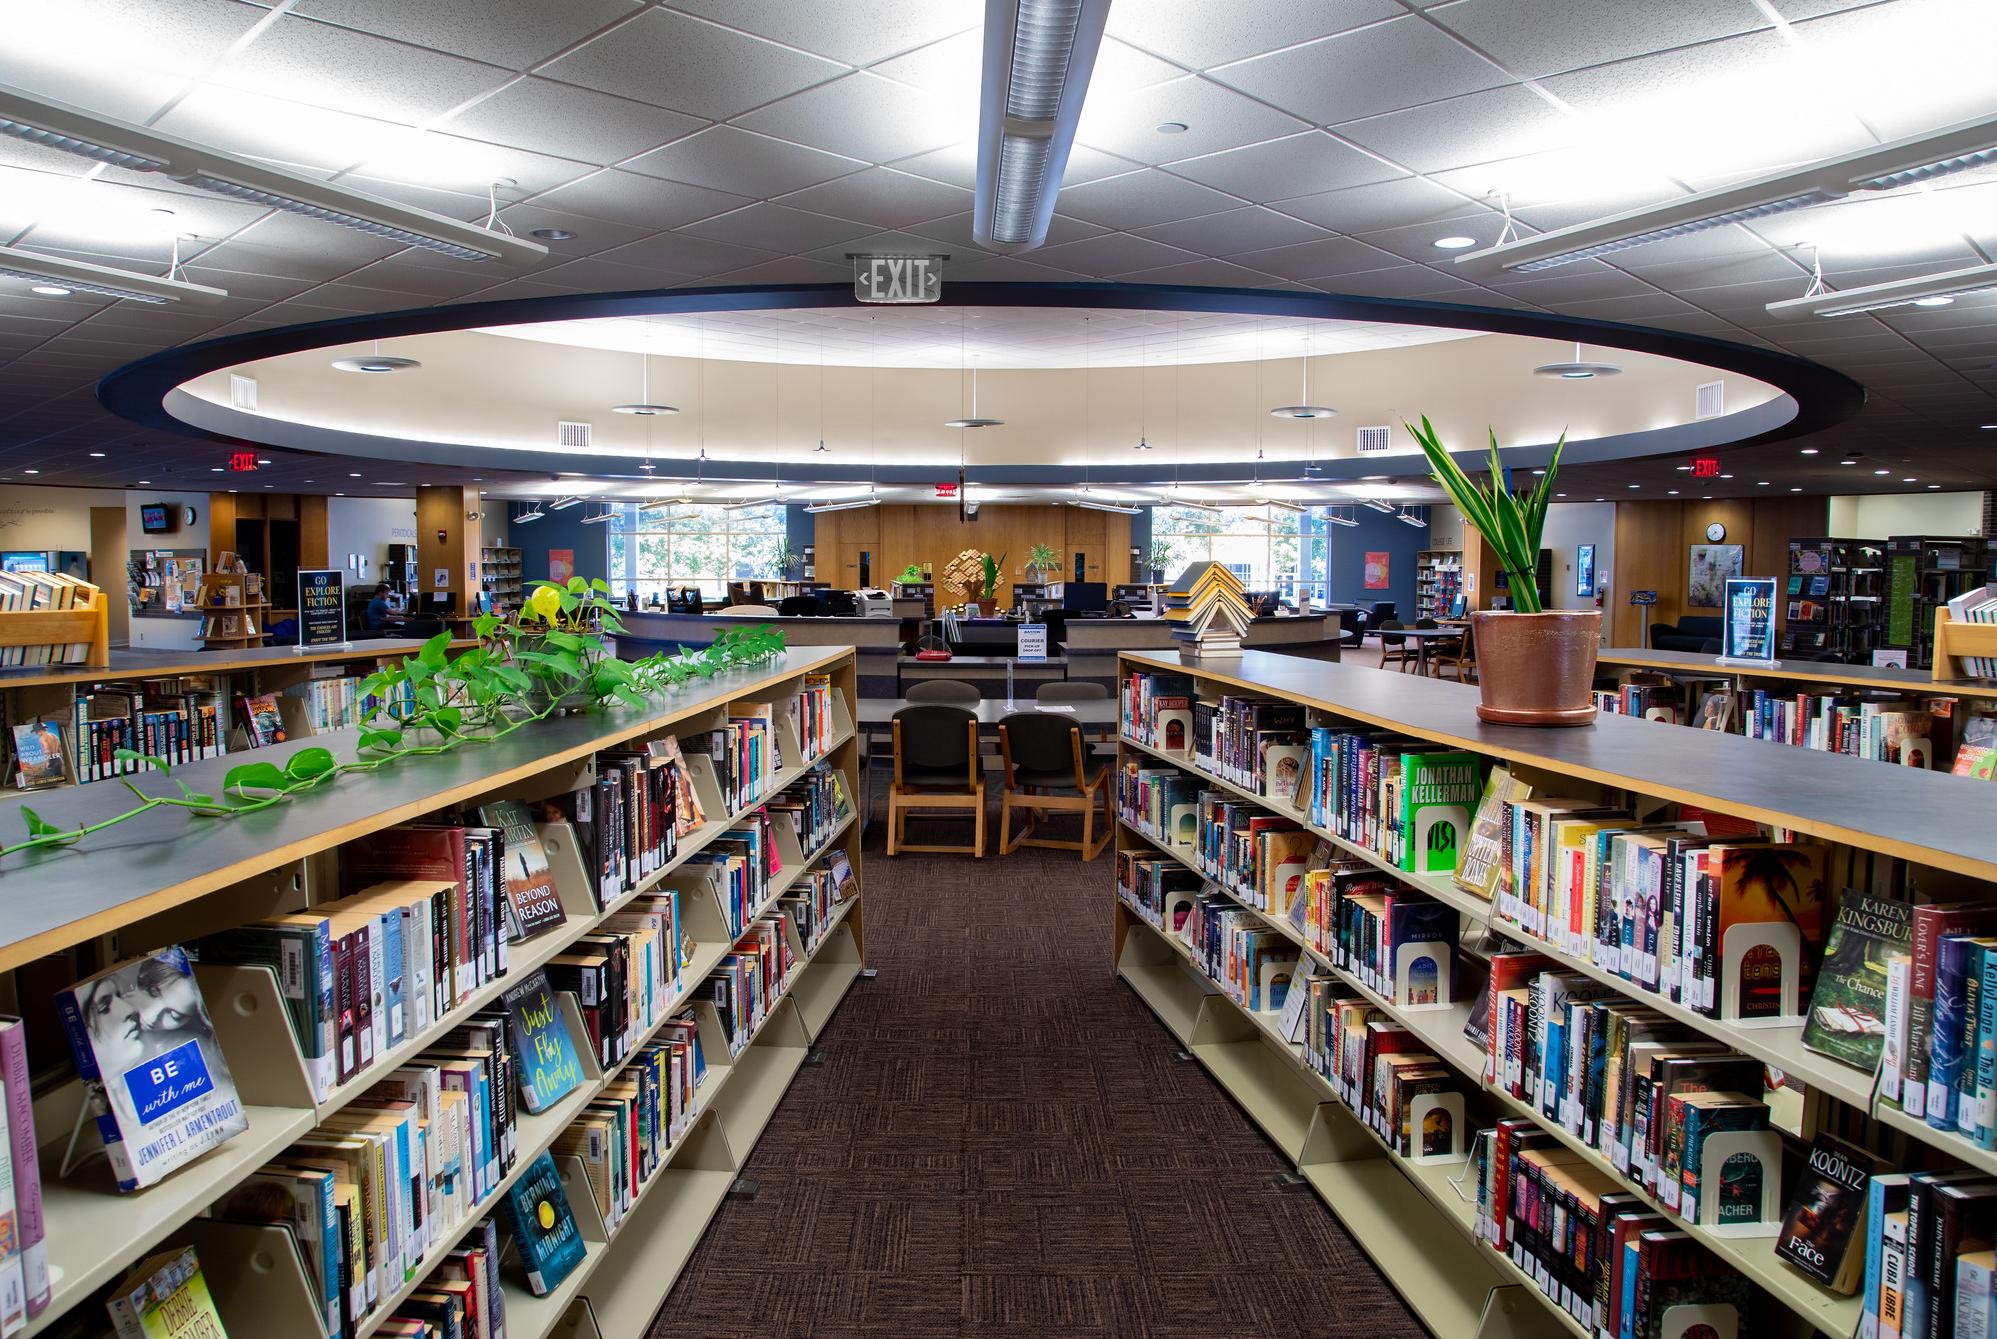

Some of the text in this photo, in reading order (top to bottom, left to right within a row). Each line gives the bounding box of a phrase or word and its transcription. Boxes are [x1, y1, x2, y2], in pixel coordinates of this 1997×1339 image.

[871, 259, 930, 298] EXIT
[233, 453, 254, 471] EXIT
[1696, 459, 1716, 476] EXIT
[305, 586, 341, 596] EXPLORE
[315, 576, 327, 585] GO
[1743, 586, 1757, 596] GO
[307, 597, 338, 607] FICTION
[1733, 597, 1771, 608] EXPLORE
[1733, 608, 1767, 618] FICTION
[1158, 700, 1168, 709] KAY
[1273, 716, 1295, 725] WHY
[1415, 766, 1472, 785] JONATHAN
[1411, 784, 1475, 804] KELLERMAN
[495, 810, 519, 828] KAT
[504, 823, 535, 843] ARTIN
[465, 852, 474, 920] REPRIEVE
[515, 884, 551, 905] BEYOND
[518, 897, 559, 922] REASON
[1836, 906, 1914, 942] KINGSBUR
[1861, 897, 1909, 923] KAREN
[1672, 925, 1680, 955] FOURTH
[1913, 915, 1933, 992] LOVER'S LANE
[1835, 974, 1847, 985] The
[1846, 977, 1885, 1000] Chance
[64, 1006, 77, 1023] BE
[521, 992, 554, 1036] Just
[1527, 989, 1539, 1041] KOONTZ
[1536, 987, 1546, 1040] KOONTZ
[1963, 977, 1979, 1048] OLIVIA TWIST
[1507, 1021, 1515, 1056] KOONTZ
[1911, 1004, 1926, 1055] Jill Marie
[534, 1031, 563, 1068] Fly
[1979, 1055, 1993, 1073] The
[150, 1060, 179, 1086] BE
[535, 1060, 577, 1098] Away
[1680, 1082, 1708, 1092] The
[11, 1041, 34, 1168] DEBBIE MACOMBER
[141, 1086, 180, 1117] with
[181, 1076, 206, 1095] me
[137, 1134, 178, 1167] JENNIFER
[178, 1131, 186, 1145] L.
[185, 1099, 239, 1140] ARMENTROUT
[1809, 1147, 1867, 1190] KOONTZ
[325, 1178, 334, 1193] ED
[362, 1176, 372, 1224] SHAME
[519, 1171, 556, 1214] BURNING
[1911, 1194, 1919, 1211] THE
[535, 1215, 575, 1262] MIDNIGHT
[1909, 1211, 1918, 1245] TOPEKA
[1788, 1235, 1825, 1266] Face
[1907, 1245, 1917, 1279] SCHOOL
[1931, 1215, 1944, 1313] JOHN LESCROART THE
[1884, 1253, 1899, 1321] CUBA LIBRE
[159, 1286, 199, 1337] DEBBIE
[1970, 1307, 1985, 1337] JOHN
